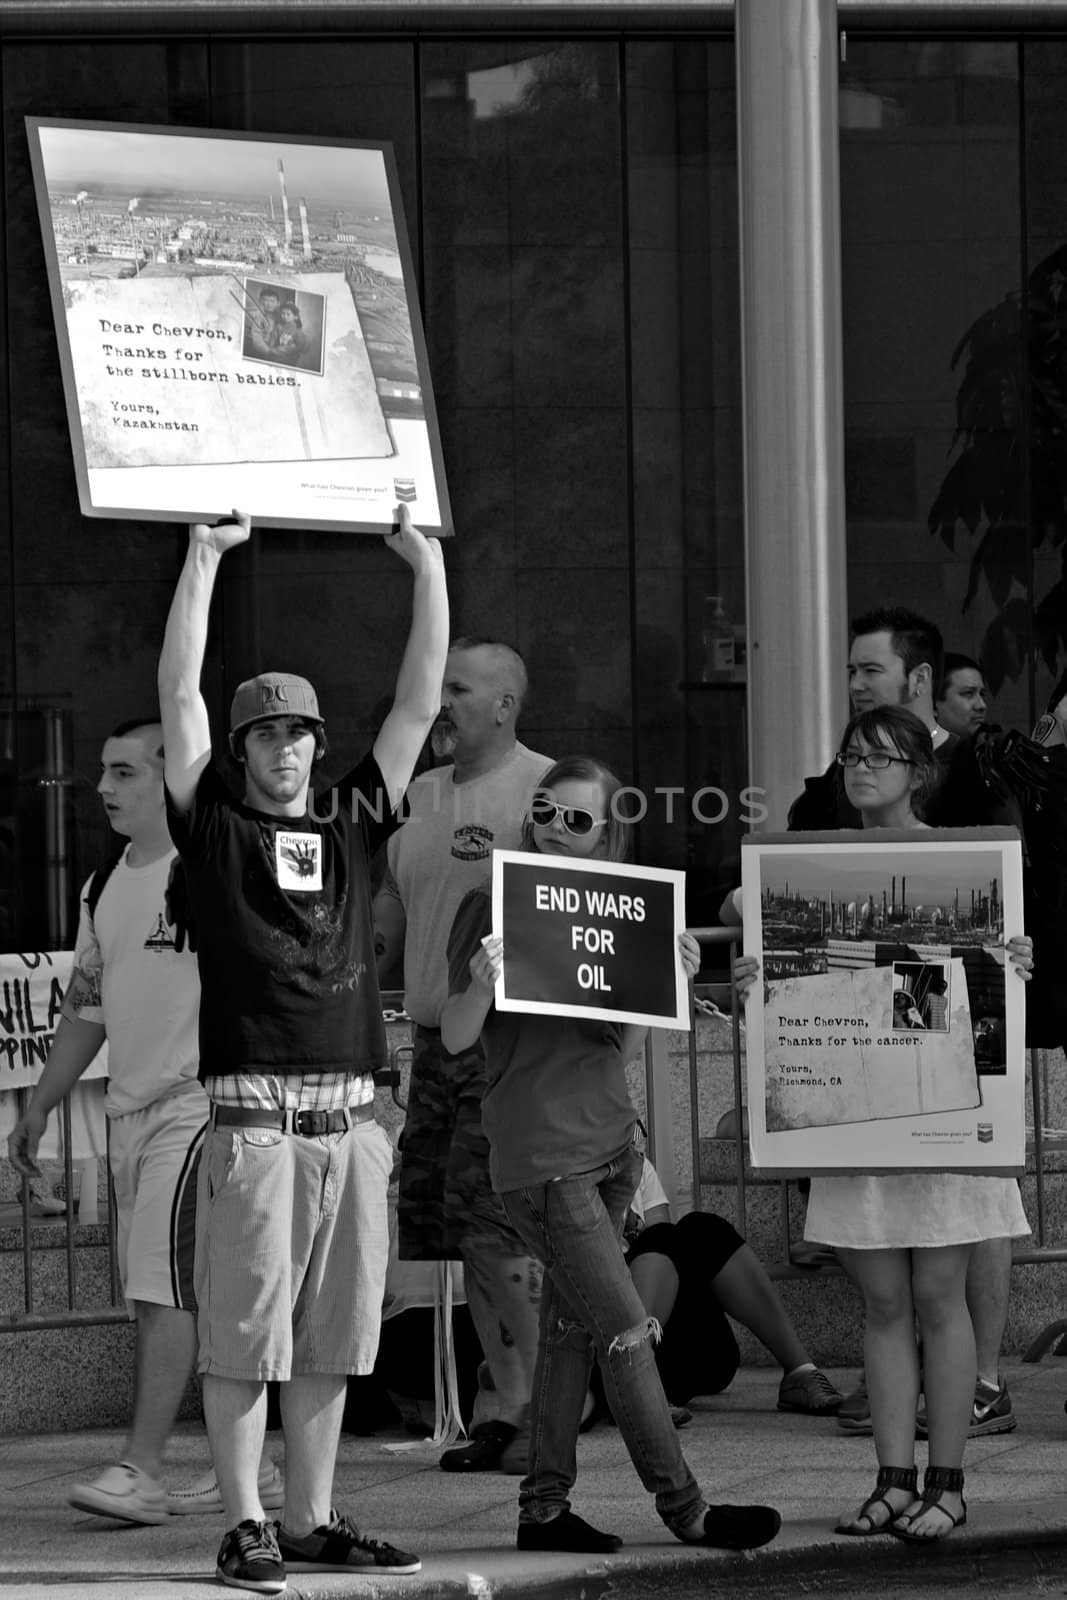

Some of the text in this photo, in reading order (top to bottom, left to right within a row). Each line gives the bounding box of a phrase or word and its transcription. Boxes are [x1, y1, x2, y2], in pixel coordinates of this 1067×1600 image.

[98, 319, 233, 342] Dear Chevron,
[102, 344, 204, 361] Thanks for
[106, 364, 302, 387] the stillborn babies.
[111, 401, 160, 416] Yours,
[112, 417, 200, 433] Kazakhstan
[536, 885, 646, 922] END WARS
[571, 926, 615, 955] FOR
[577, 963, 612, 992] OIL
[779, 1016, 869, 1028] Dear Chevron,
[778, 1036, 923, 1046] Thanks for the cancer.
[779, 1065, 812, 1074] Yours,
[830, 1077, 842, 1086] CA
